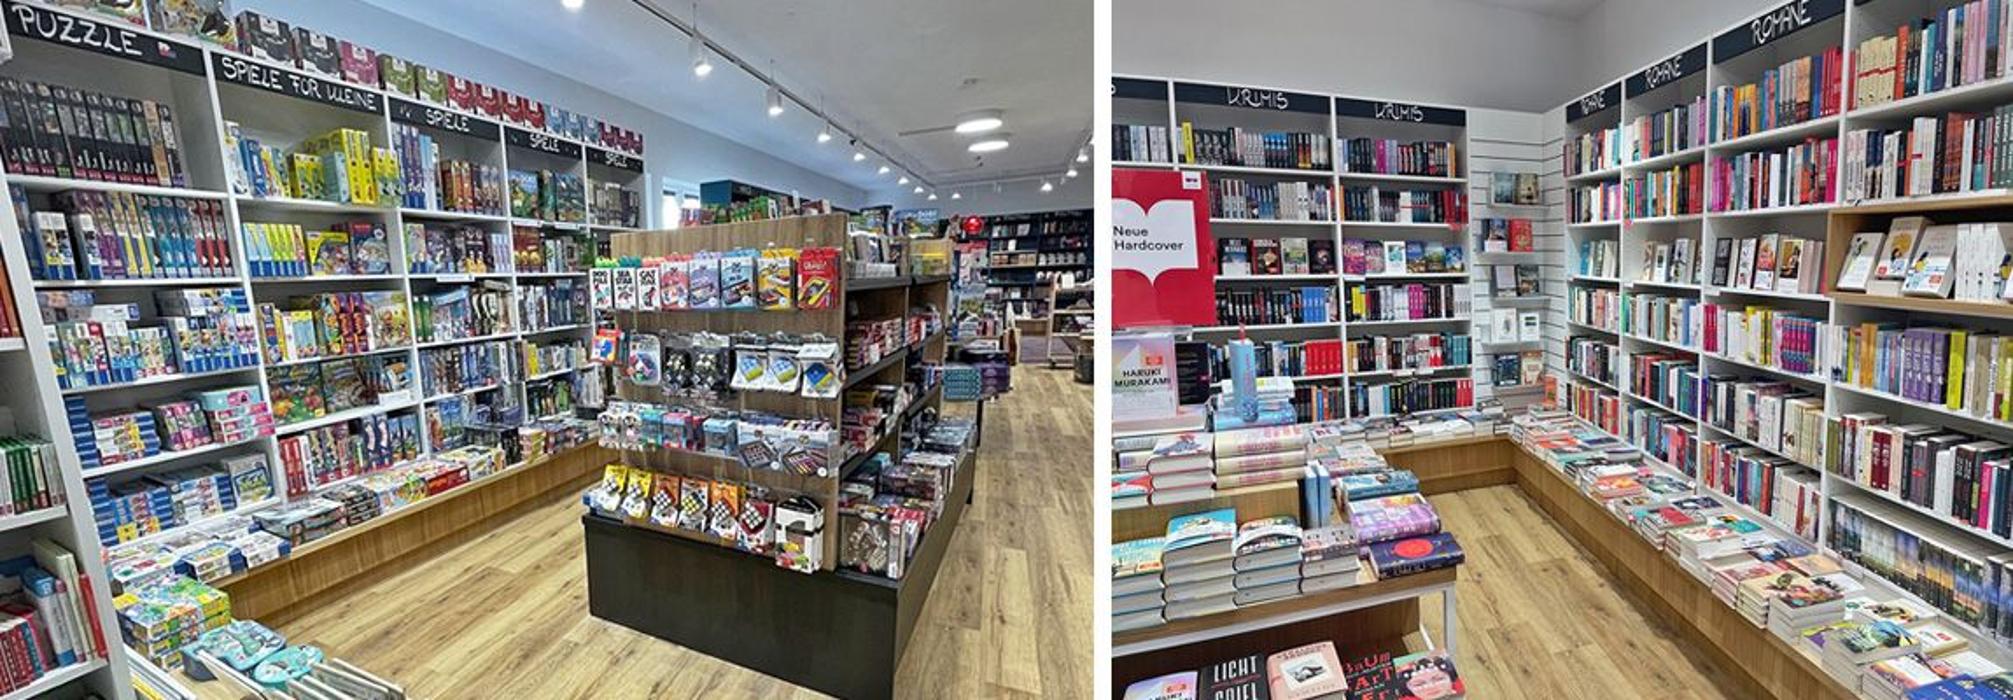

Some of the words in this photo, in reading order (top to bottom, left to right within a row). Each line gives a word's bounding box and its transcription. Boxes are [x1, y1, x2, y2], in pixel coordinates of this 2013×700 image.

[12, 5, 143, 56] PUZZLE
[1751, 0, 1811, 44] ROMANE
[222, 56, 283, 91] SPIELE
[1645, 56, 1682, 89] ROMANE
[1227, 87, 1289, 110] KRIMIS
[1374, 102, 1424, 122] KRIMIS
[1113, 225, 1149, 237] Neue
[1114, 239, 1184, 251] Hardcover
[1114, 377, 1171, 388] MURAKAMI
[1122, 368, 1162, 377] HARUKI
[1213, 655, 1258, 683] LICHT
